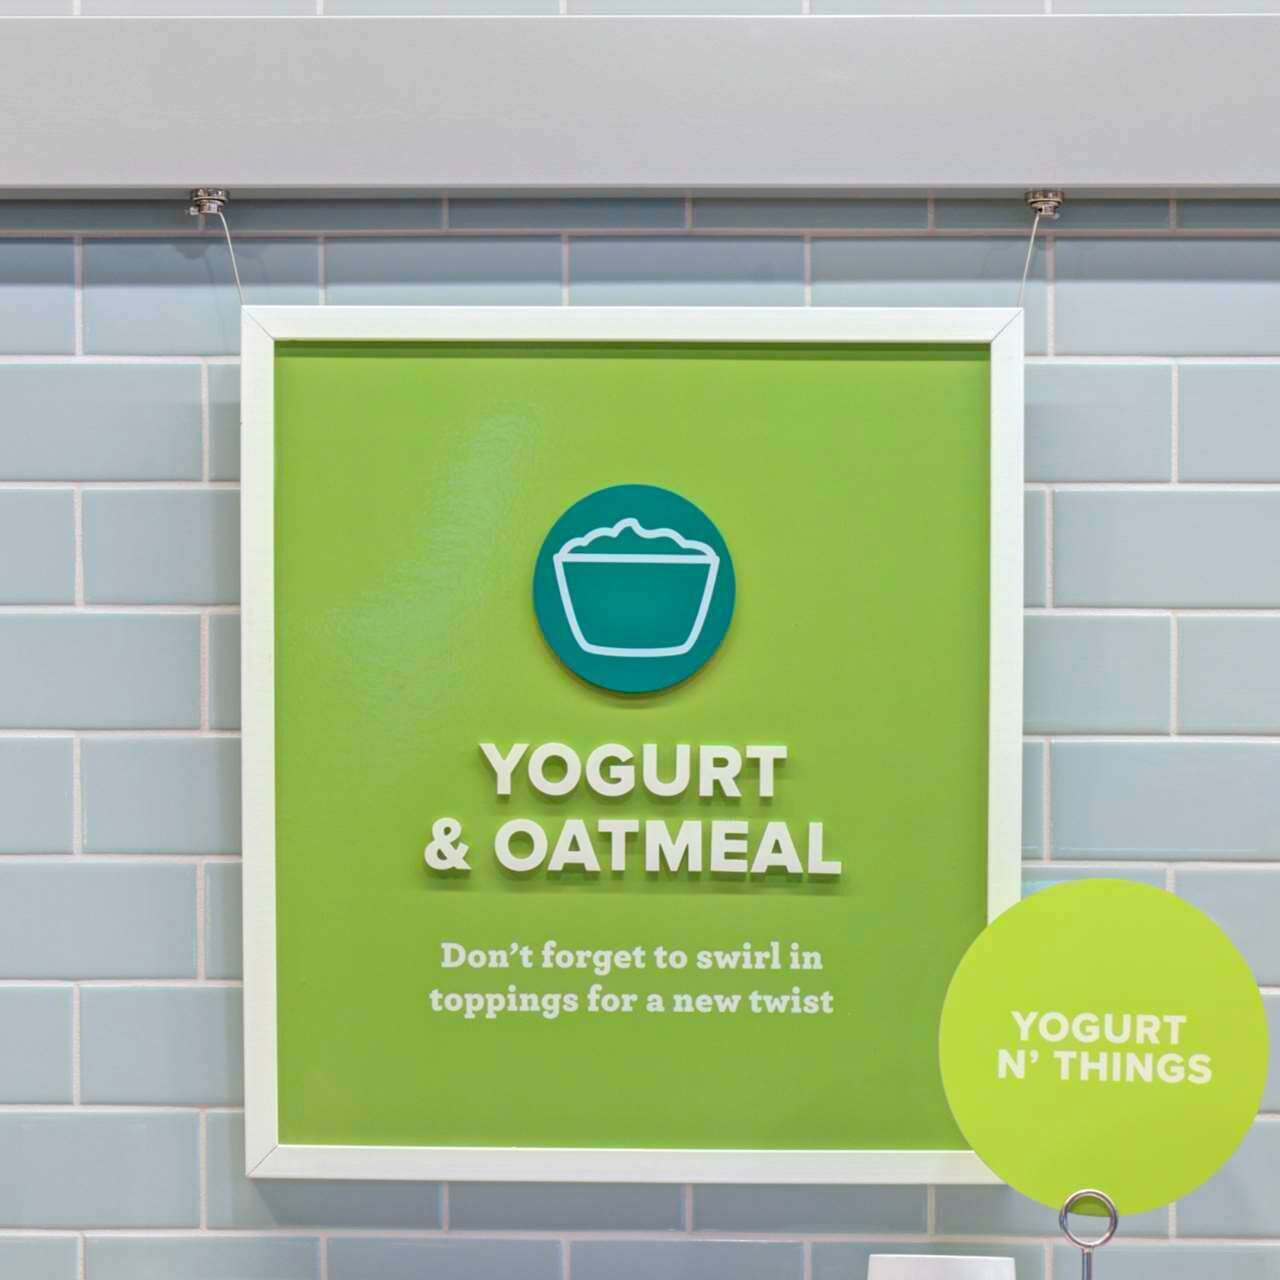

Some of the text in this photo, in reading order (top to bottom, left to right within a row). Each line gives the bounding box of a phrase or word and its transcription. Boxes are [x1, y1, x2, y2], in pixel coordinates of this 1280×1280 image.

[479, 742, 788, 797] YOGURT
[424, 818, 842, 874] & OATMEAL
[440, 940, 824, 975] Don’t forget to swirl in
[429, 984, 834, 1018] toppings for a new twist
[1011, 1011, 1187, 1044] YOGURT
[997, 1049, 1213, 1084] N’ THINGS
